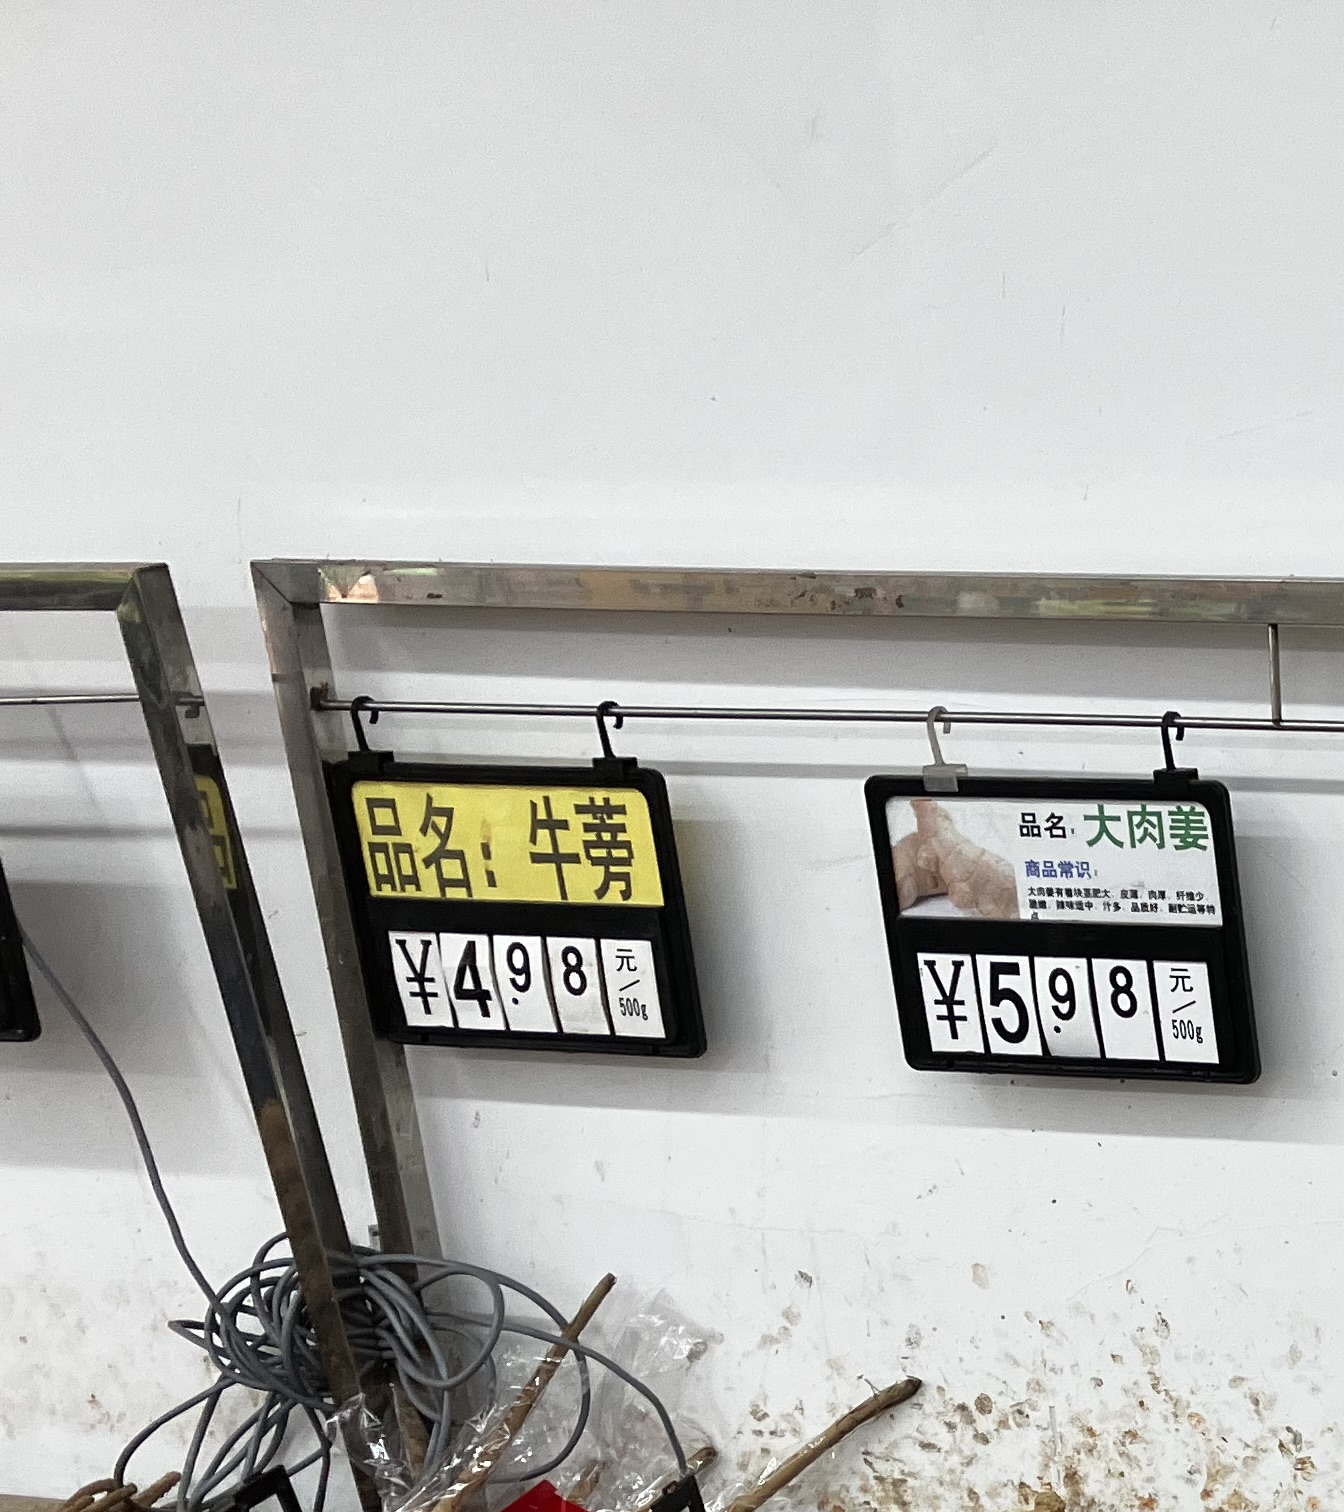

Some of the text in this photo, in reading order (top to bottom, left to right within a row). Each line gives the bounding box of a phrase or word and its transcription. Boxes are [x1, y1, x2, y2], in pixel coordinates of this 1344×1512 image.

[529, 796, 634, 900] 牛蒡
[1083, 804, 1210, 851] 大肉姜
